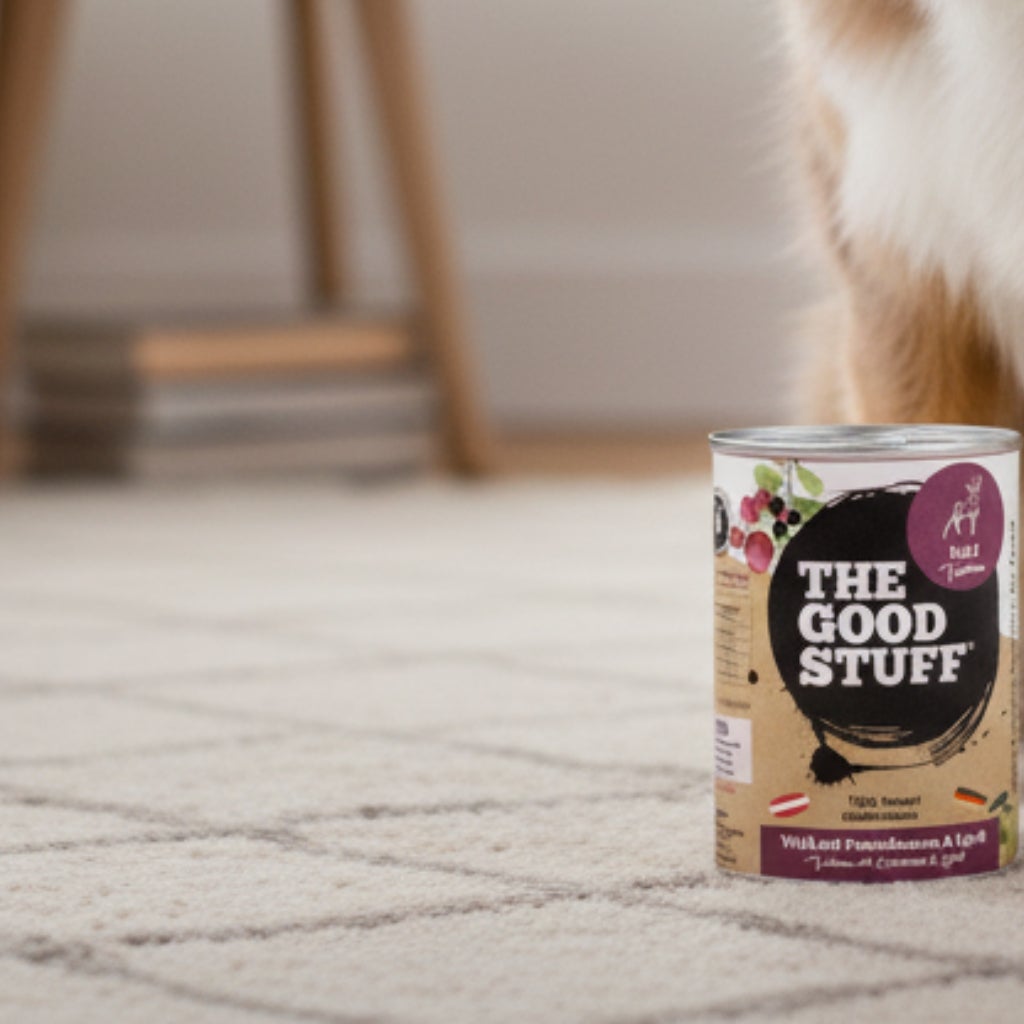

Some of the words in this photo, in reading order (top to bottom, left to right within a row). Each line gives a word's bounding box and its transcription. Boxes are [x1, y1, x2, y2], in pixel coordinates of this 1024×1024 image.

[798, 561, 907, 600] THE
[798, 603, 947, 644] GOOD
[799, 642, 968, 687] STUFF
